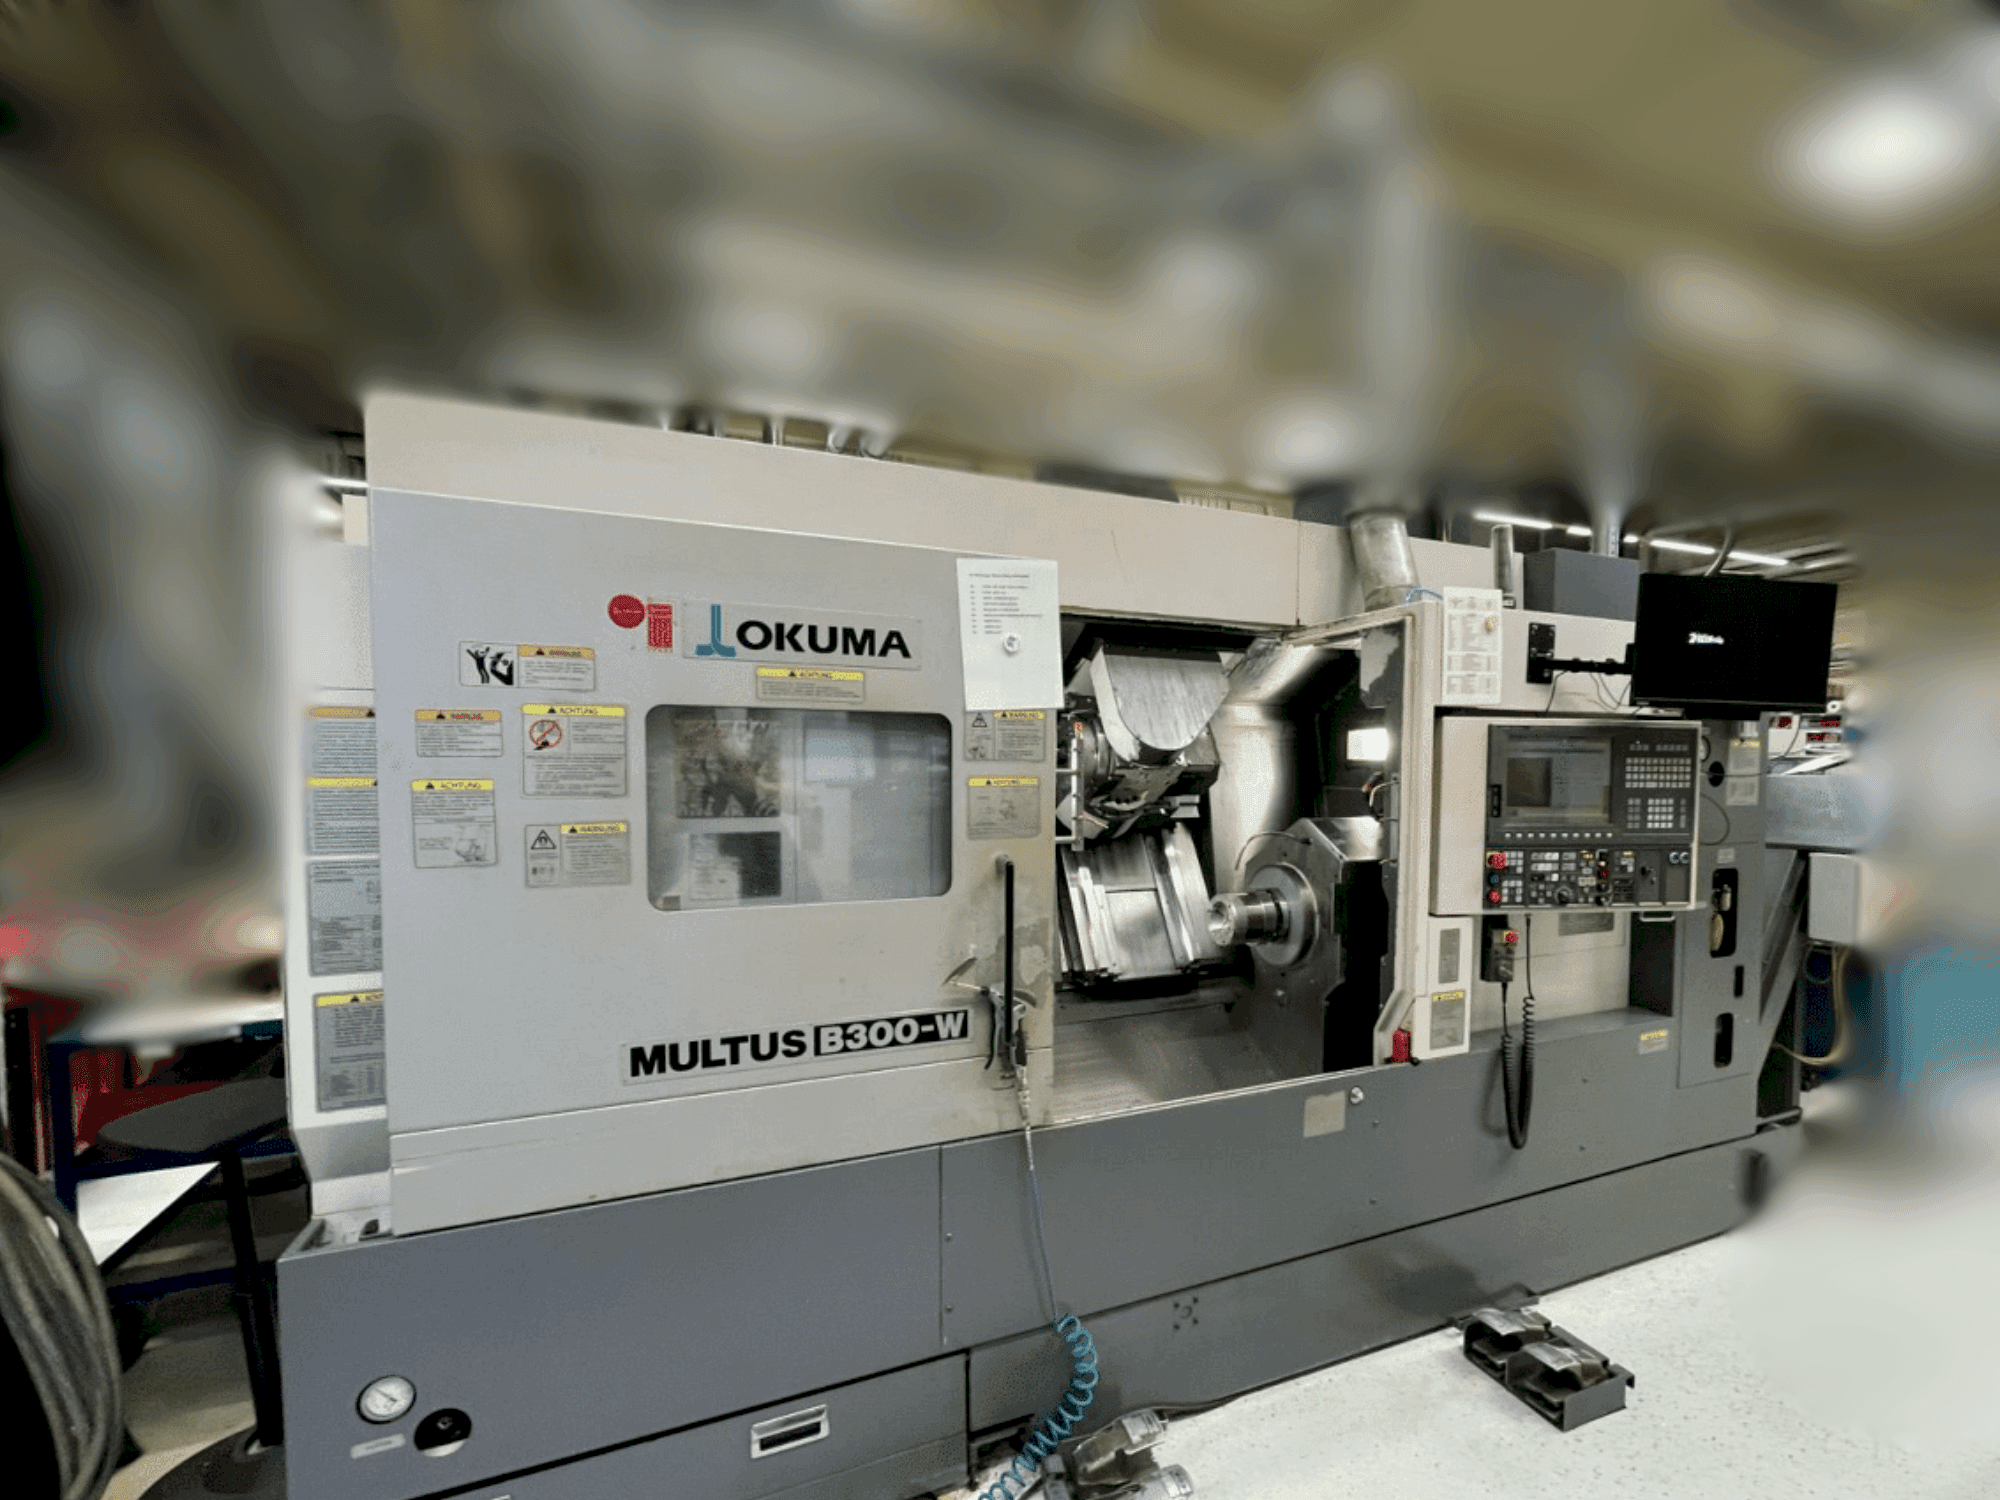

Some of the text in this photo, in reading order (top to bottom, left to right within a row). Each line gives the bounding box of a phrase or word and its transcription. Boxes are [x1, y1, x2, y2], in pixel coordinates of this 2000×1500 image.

[736, 619, 912, 659] OKUMA
[630, 1012, 966, 1077] MULTUS B300-W
